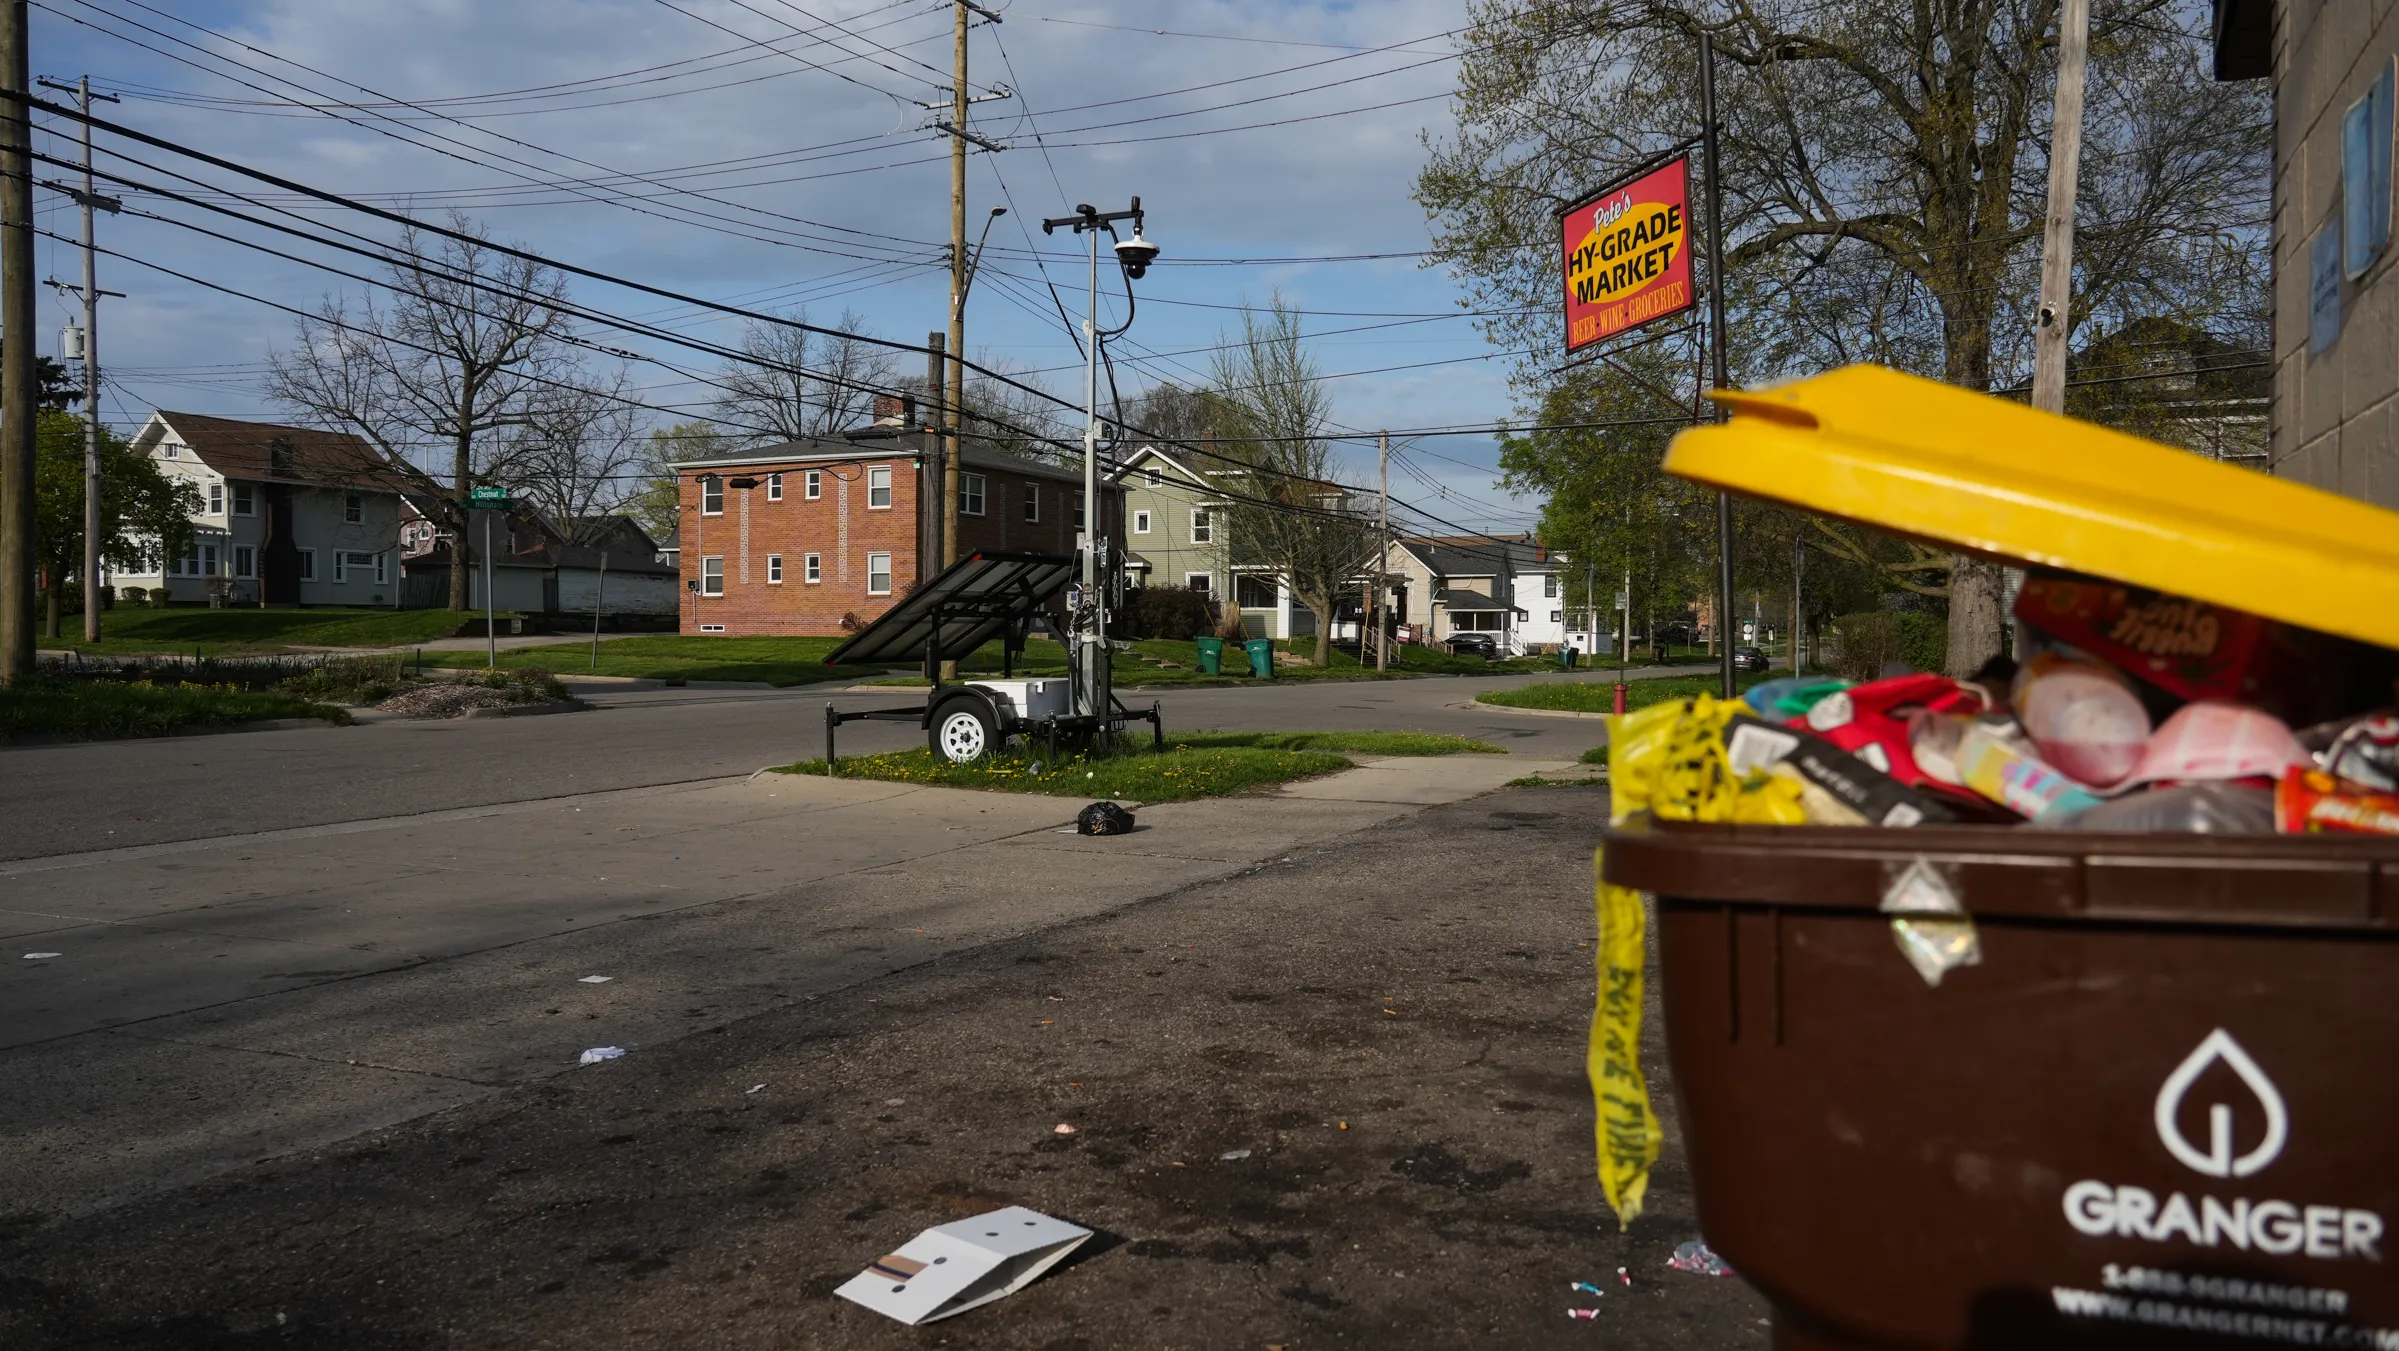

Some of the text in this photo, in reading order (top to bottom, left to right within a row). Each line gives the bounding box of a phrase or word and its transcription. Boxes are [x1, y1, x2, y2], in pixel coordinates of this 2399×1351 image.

[1568, 203, 1681, 278] HY-GRADE
[1593, 190, 1632, 235] Pete's
[1577, 242, 1674, 307] MARKET
[1572, 281, 1684, 344] BEER WINE GROCERIES
[475, 500, 503, 509] Hillsdale
[477, 490, 499, 498] Chestnut
[2062, 1179, 2383, 1261] GRANGER
